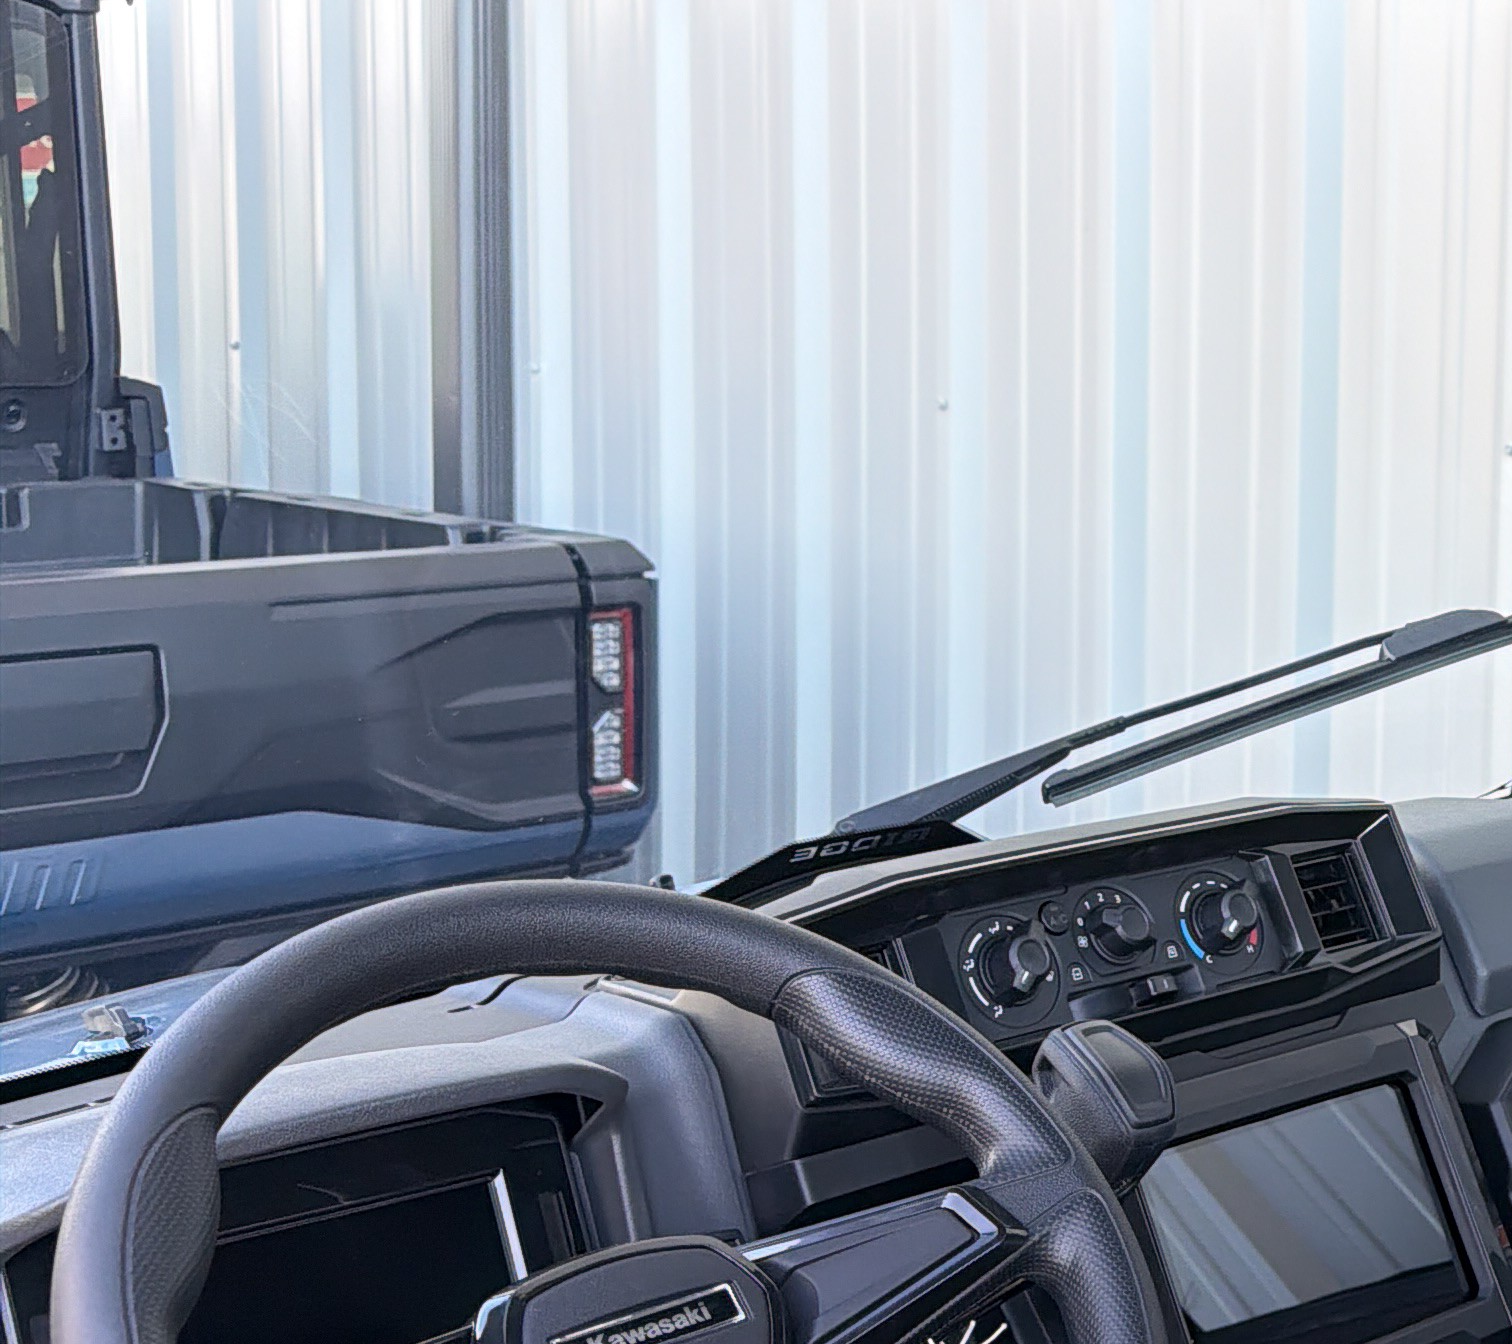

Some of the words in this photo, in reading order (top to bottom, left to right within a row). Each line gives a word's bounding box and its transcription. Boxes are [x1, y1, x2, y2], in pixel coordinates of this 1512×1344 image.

[1084, 901, 1090, 910] 1
[1097, 893, 1104, 902] 2
[1114, 894, 1121, 903] 3
[1206, 955, 1213, 963] C
